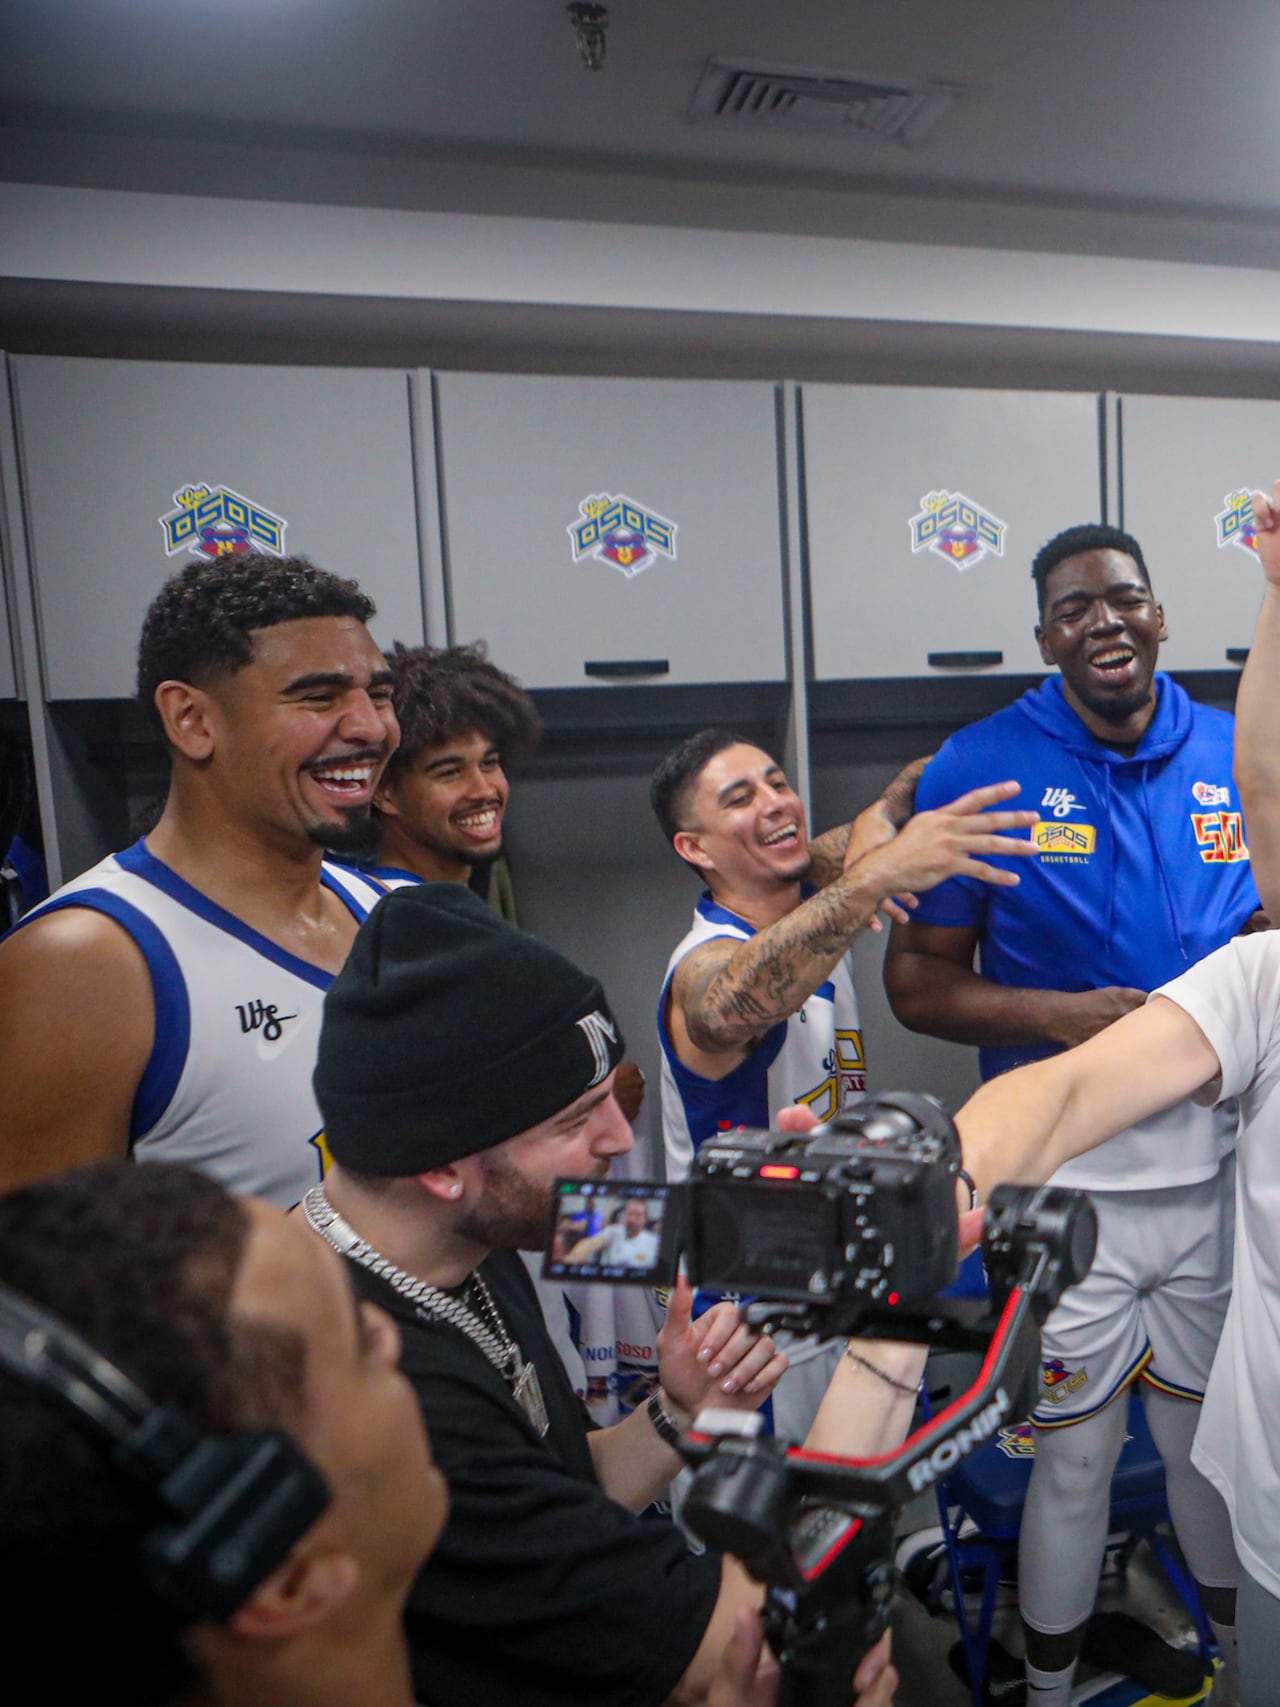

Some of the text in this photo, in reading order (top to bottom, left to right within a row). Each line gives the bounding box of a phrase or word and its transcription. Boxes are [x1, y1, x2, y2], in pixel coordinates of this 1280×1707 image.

[167, 491, 284, 552] OSOS
[574, 500, 674, 556] OSOS
[916, 500, 1002, 549] OSOS
